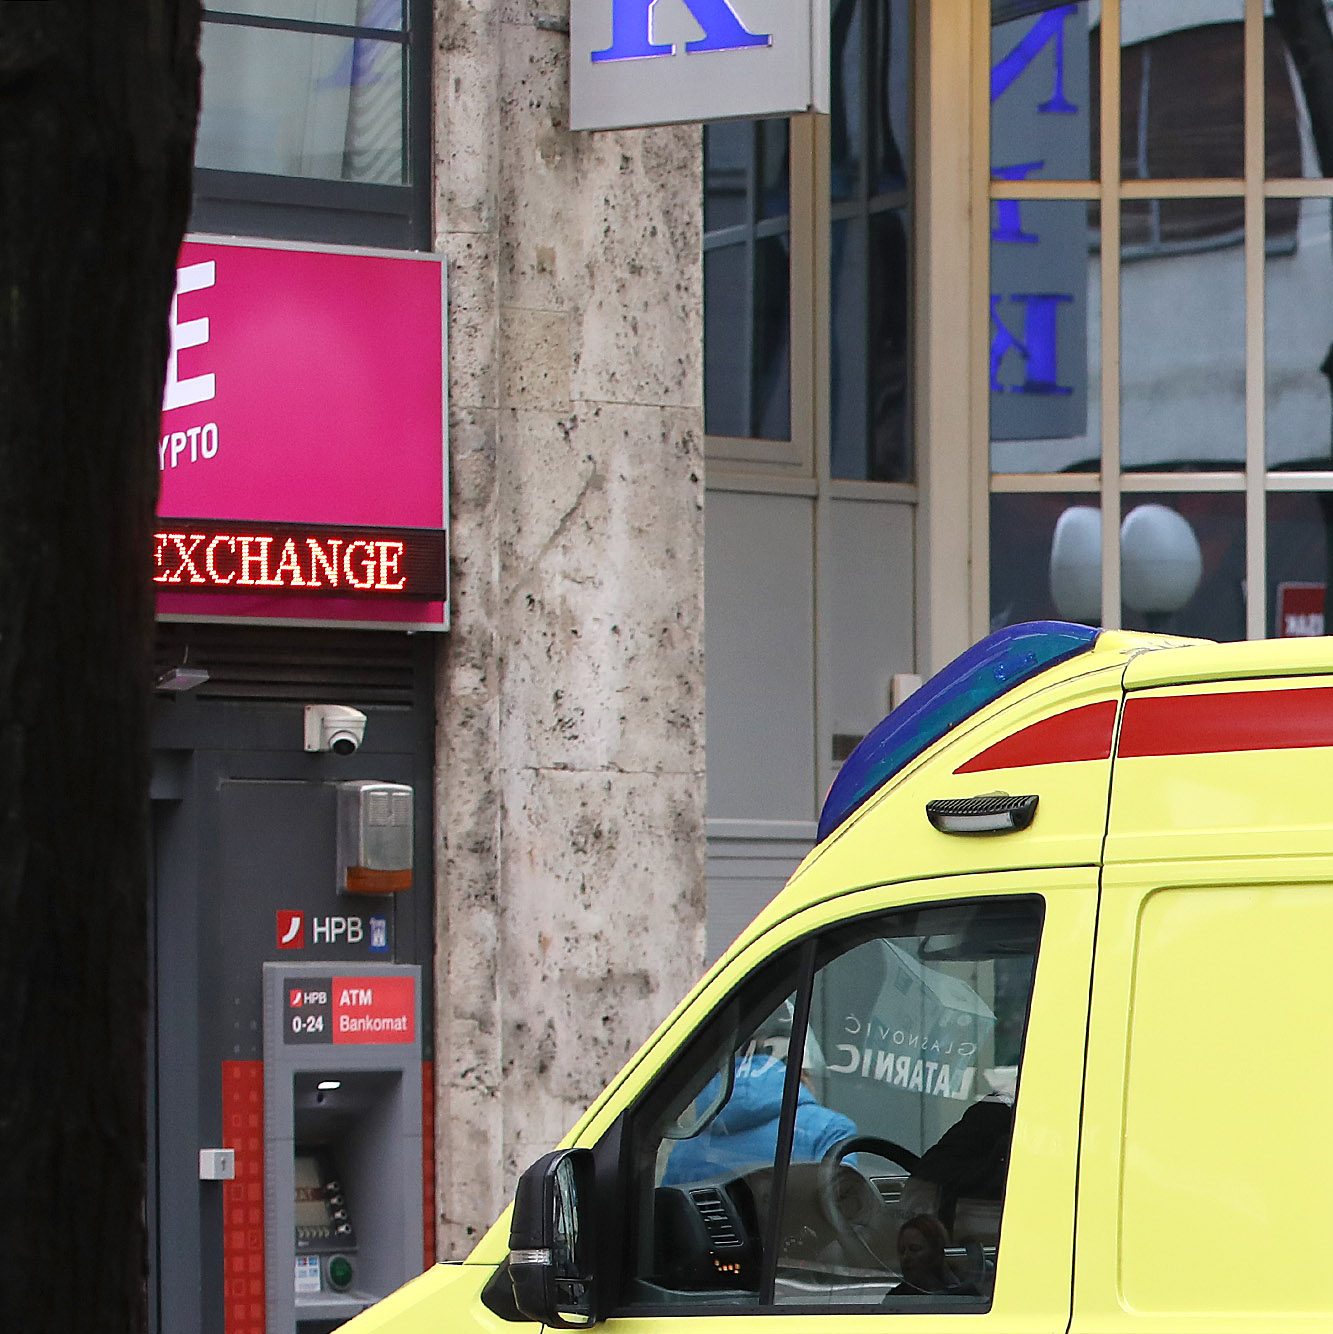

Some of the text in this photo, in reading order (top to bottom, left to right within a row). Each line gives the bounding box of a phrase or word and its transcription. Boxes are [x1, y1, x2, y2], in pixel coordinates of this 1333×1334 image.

[313, 916, 363, 943] HPB
[303, 991, 327, 1005] HPB
[339, 989, 373, 1006] ATM
[292, 1015, 324, 1033] 0-24
[339, 1014, 408, 1032] Bankomat
